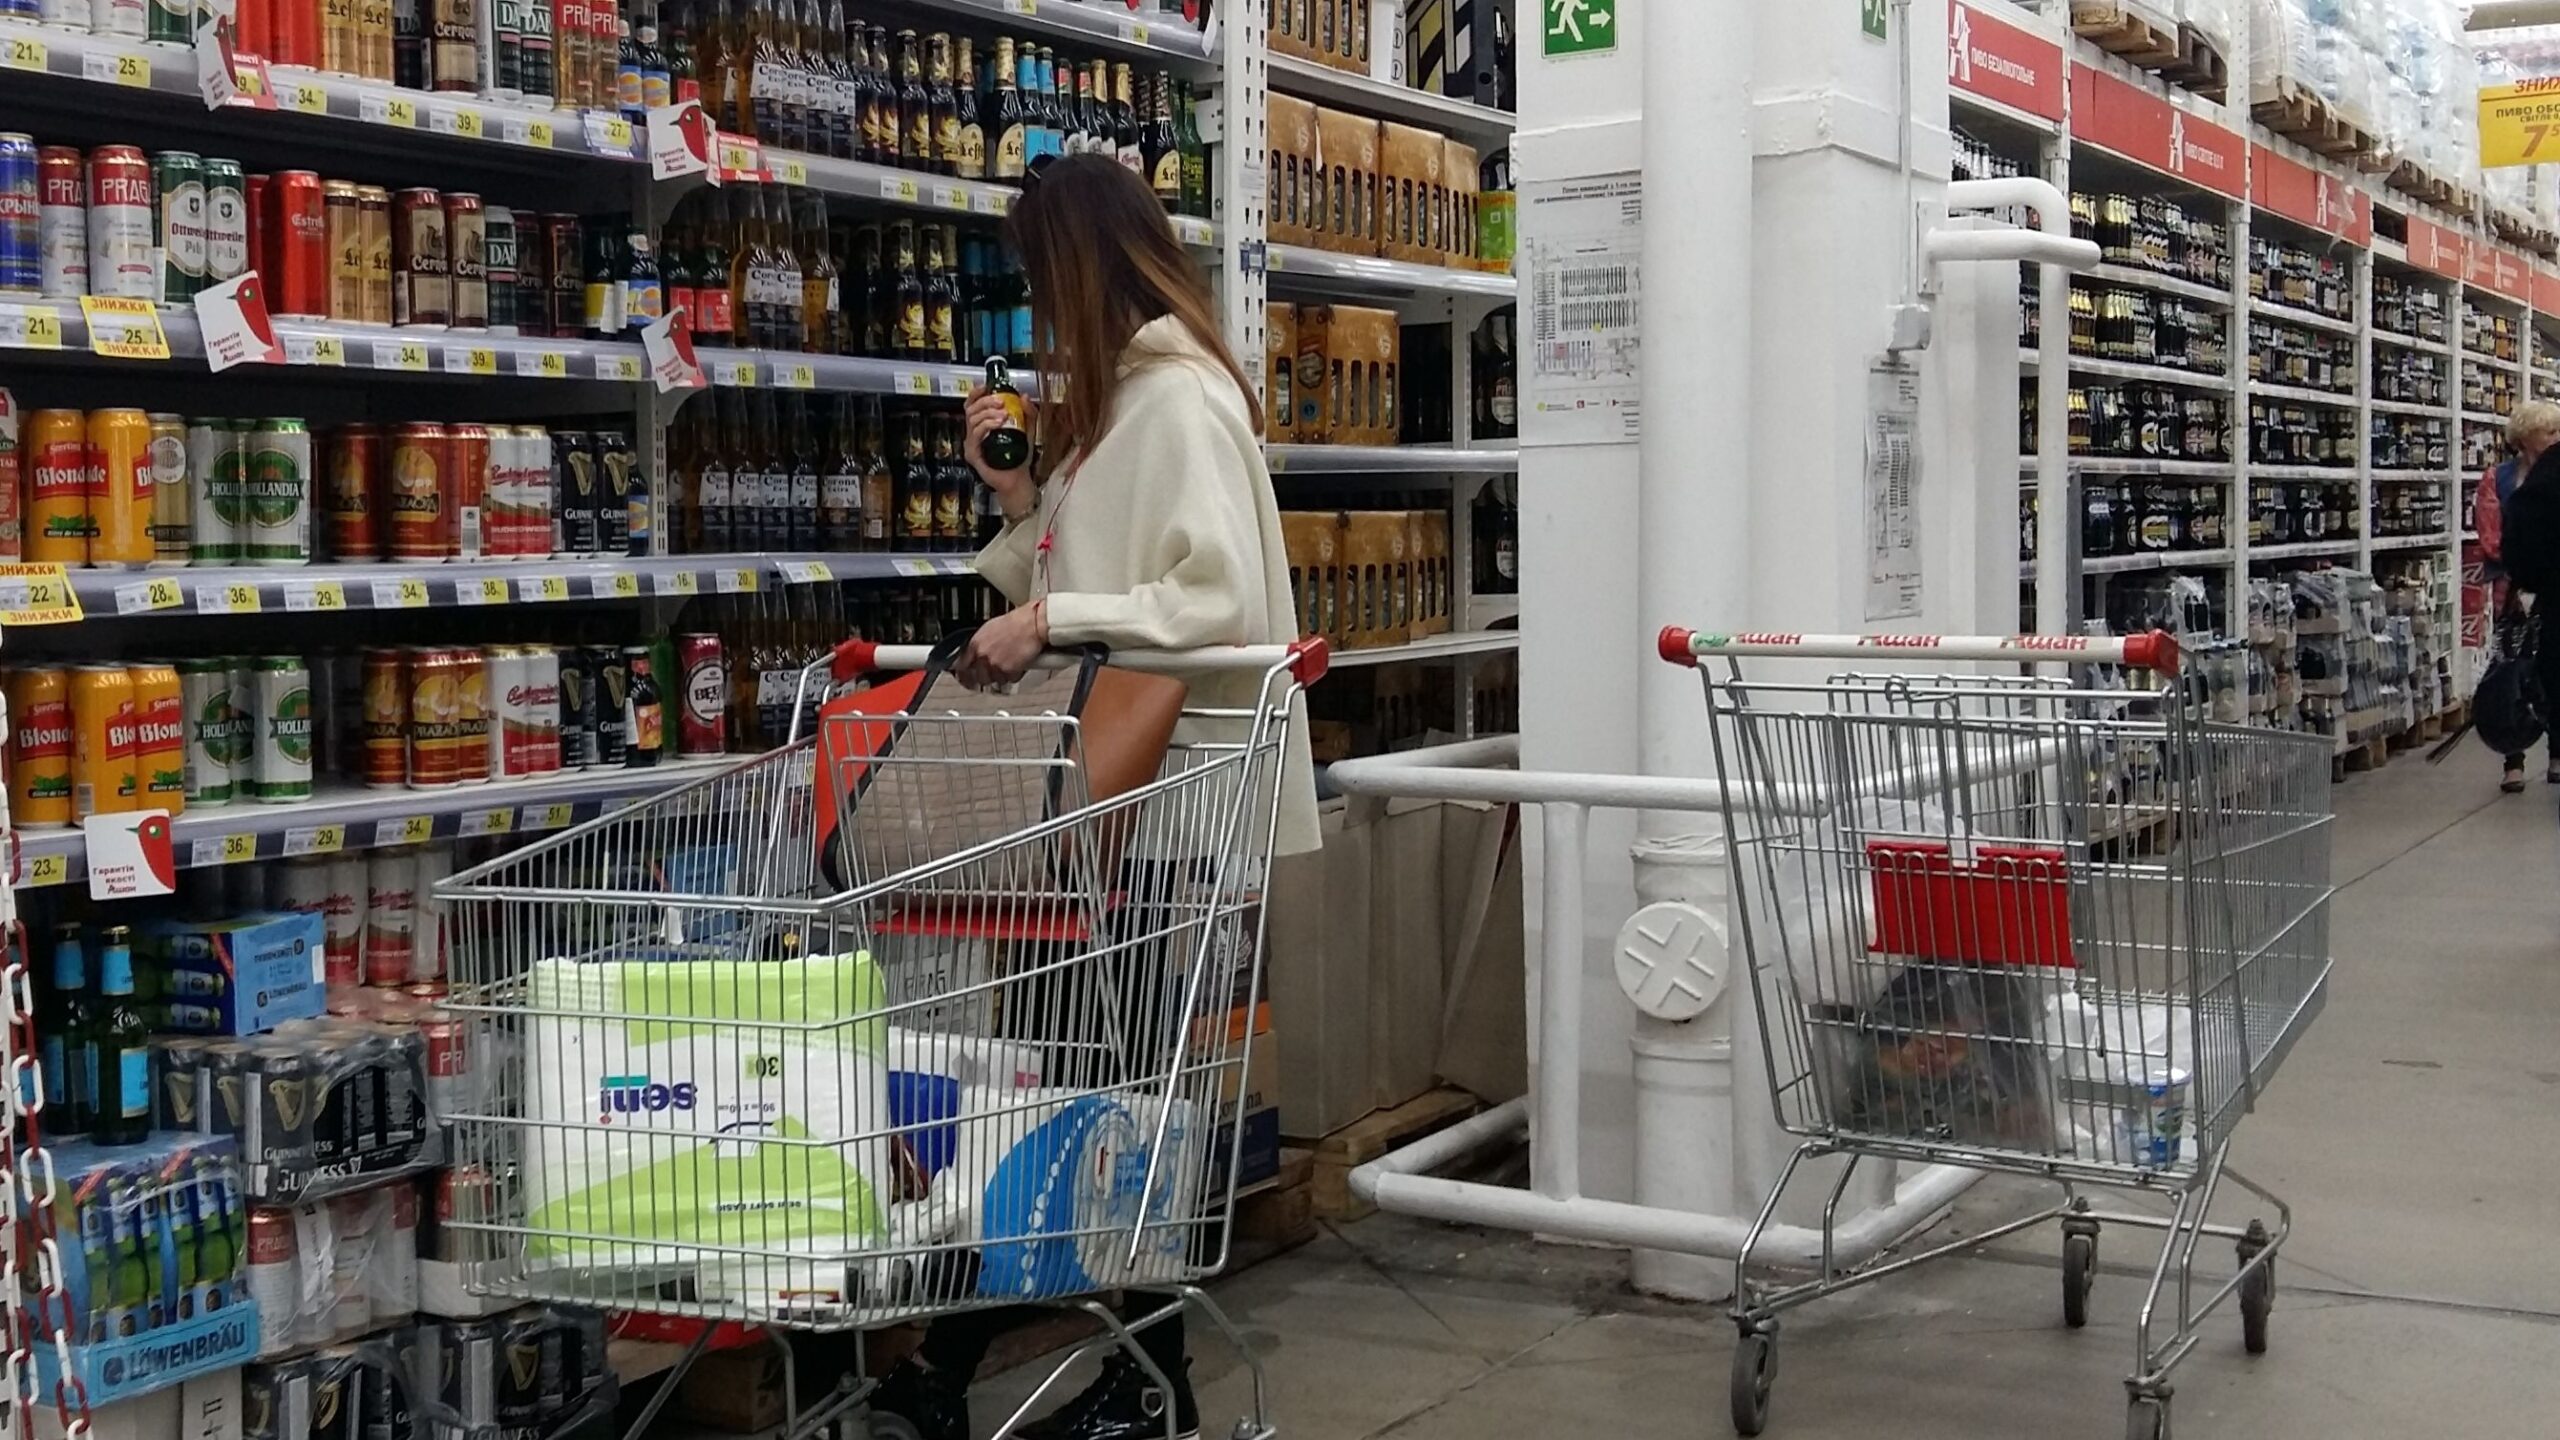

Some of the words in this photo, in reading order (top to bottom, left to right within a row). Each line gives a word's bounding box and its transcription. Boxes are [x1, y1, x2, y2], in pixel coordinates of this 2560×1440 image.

[2496, 106, 2533, 119] ПИВО
[2520, 114, 2552, 123] СВІТЛЕ
[128, 1321, 246, 1382] LÖWENBRÄU
